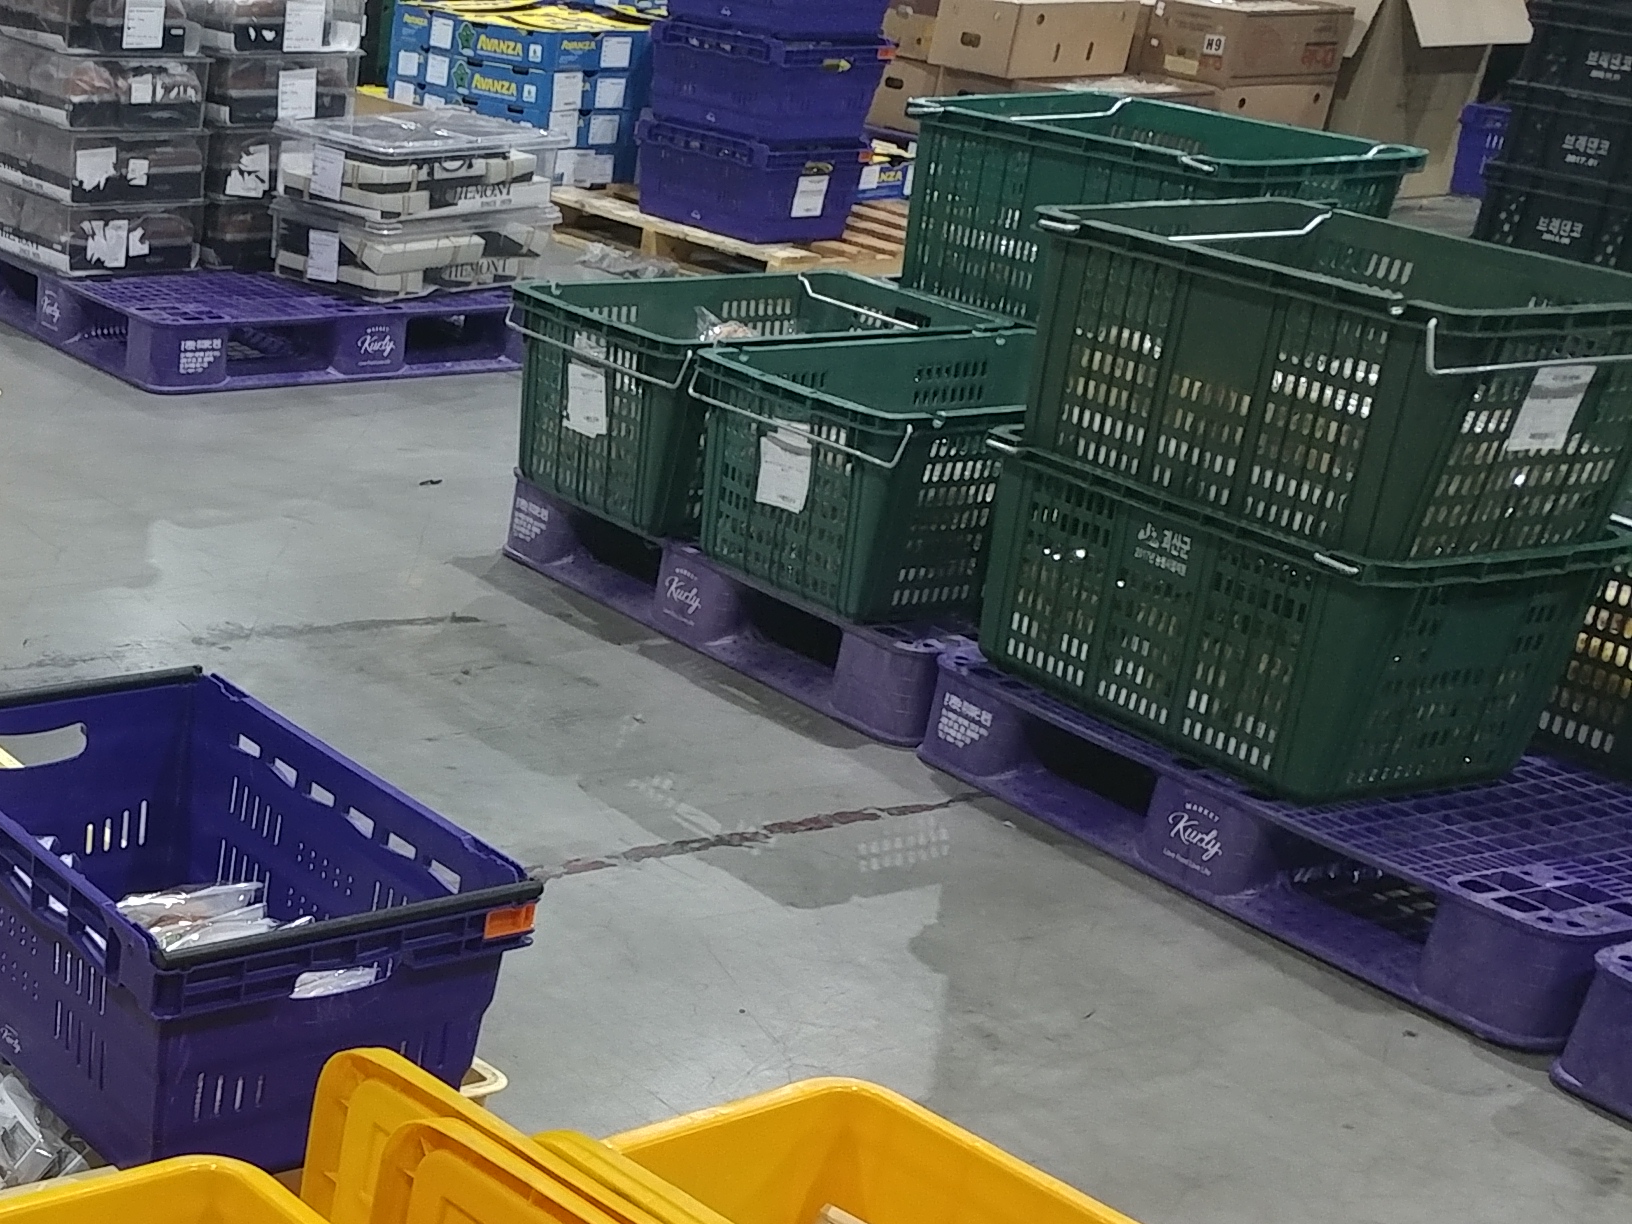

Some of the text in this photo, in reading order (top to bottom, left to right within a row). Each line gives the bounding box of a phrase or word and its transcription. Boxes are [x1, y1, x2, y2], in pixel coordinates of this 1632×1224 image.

[477, 33, 524, 57] AVANZA
[471, 72, 517, 96] AVANZA
[357, 334, 396, 354] Kurly
[664, 575, 701, 615] Kurly
[1168, 811, 1223, 862] Kurly
